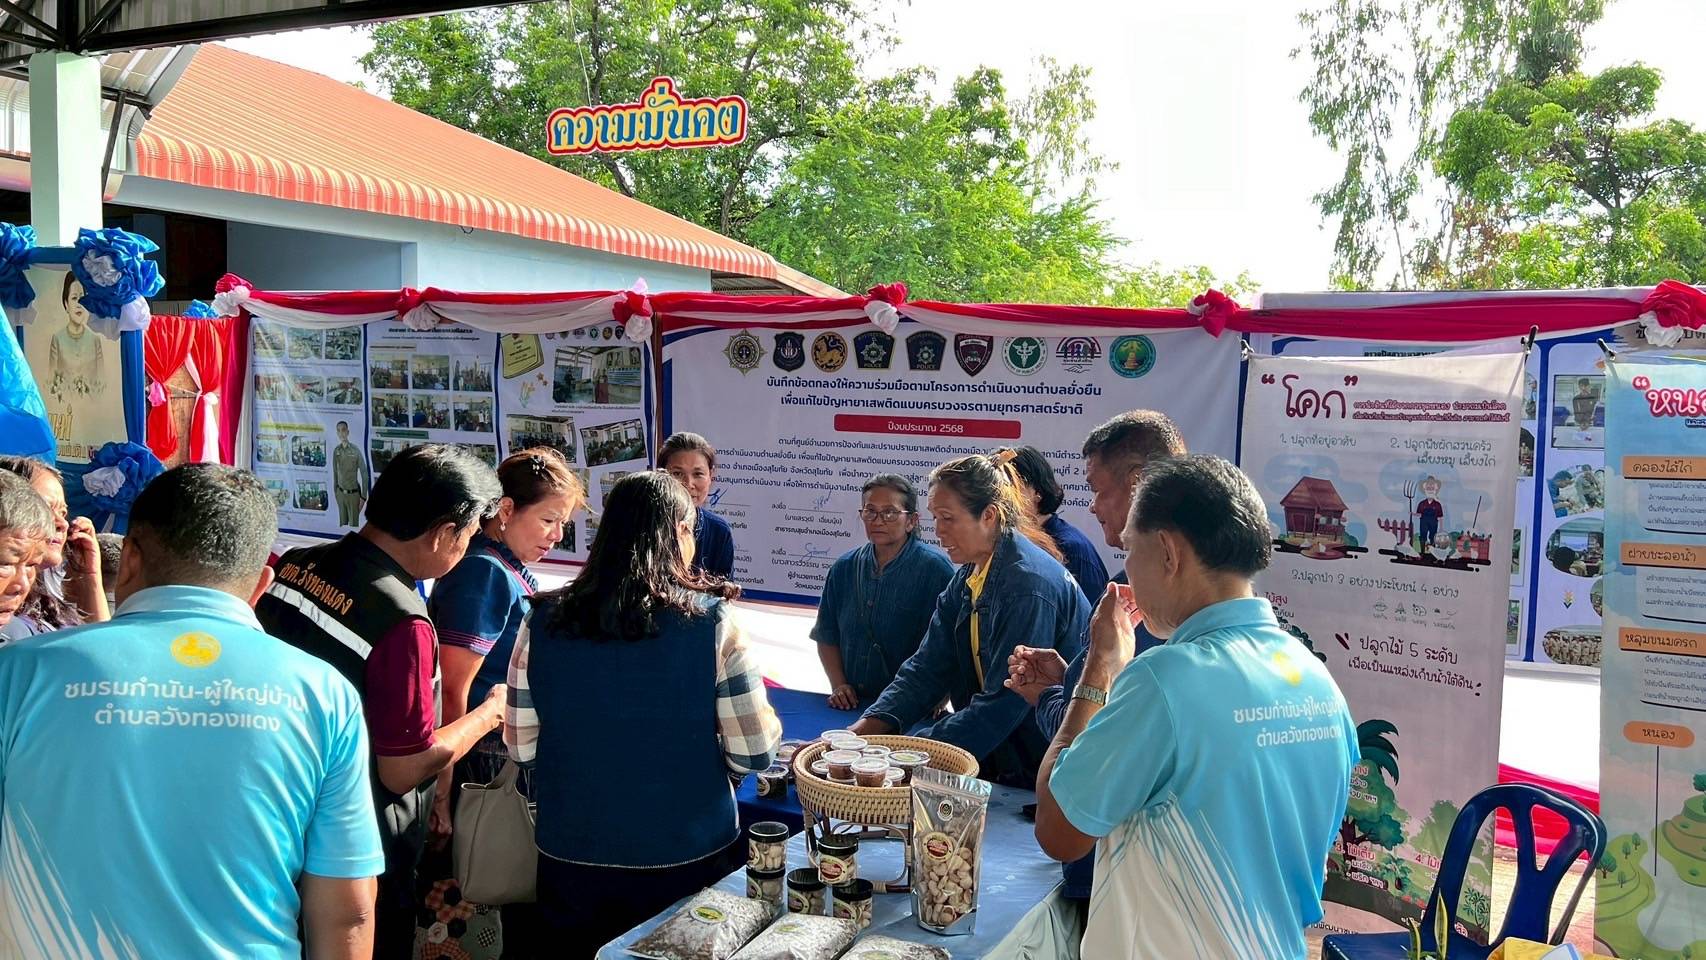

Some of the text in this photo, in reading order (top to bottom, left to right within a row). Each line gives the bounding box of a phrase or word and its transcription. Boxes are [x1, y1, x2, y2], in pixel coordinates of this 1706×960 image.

[554, 86, 739, 146] ความมั่นคง
[767, 375, 1102, 396] บันทึกข้อตกลงให้ความร่วมมือตามโครงการดำเนินงานตำบลยั่งยืน
[781, 391, 1083, 415] เพื่อแก้ไขปัญหายาเสพติดแบบครบวงจรตามยุทธศาสตร์ชาติ
[888, 421, 964, 433] ปีงบประมาณ 2568
[1390, 437, 1492, 453] 2. ปลูกพืชผักสวนครัว
[1073, 467, 1079, 475] 2
[1632, 459, 1693, 473] คลองไส้ไก่
[1628, 547, 1697, 562] ฝายชะลอน้ำ
[1338, 573, 1345, 585] 3
[1421, 585, 1428, 595] 4
[1625, 633, 1698, 649] หลุมขนมครก
[1360, 635, 1458, 665] ปลูกไม้ 5 ระดับ
[94, 705, 282, 733] ตำบลวังทองแดง
[1642, 728, 1676, 740] หนอง
[1335, 842, 1345, 854] 3.
